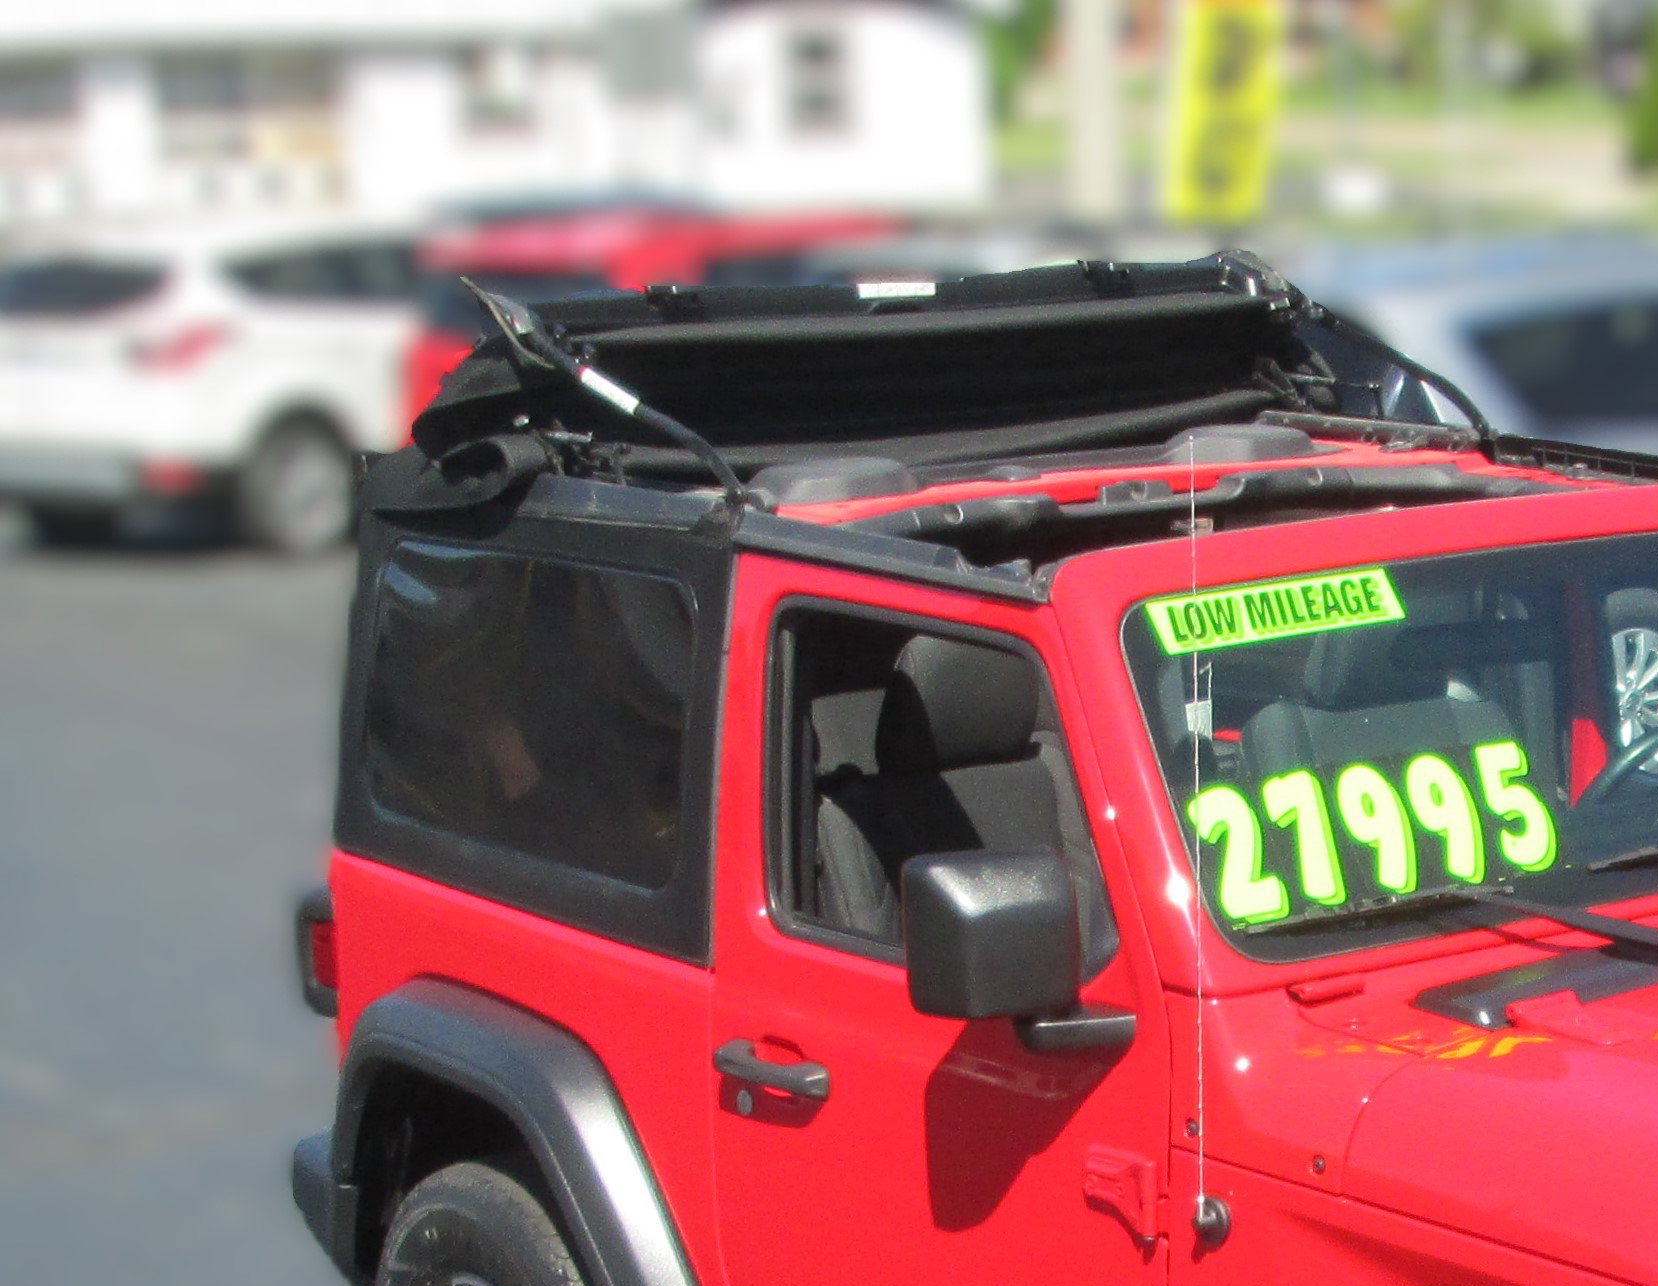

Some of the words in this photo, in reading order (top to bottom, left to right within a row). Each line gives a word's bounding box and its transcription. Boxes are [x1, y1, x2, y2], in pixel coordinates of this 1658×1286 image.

[1166, 596, 1237, 643] LOW
[1242, 576, 1382, 632] MILEAGE
[1187, 740, 1557, 924] 27995
